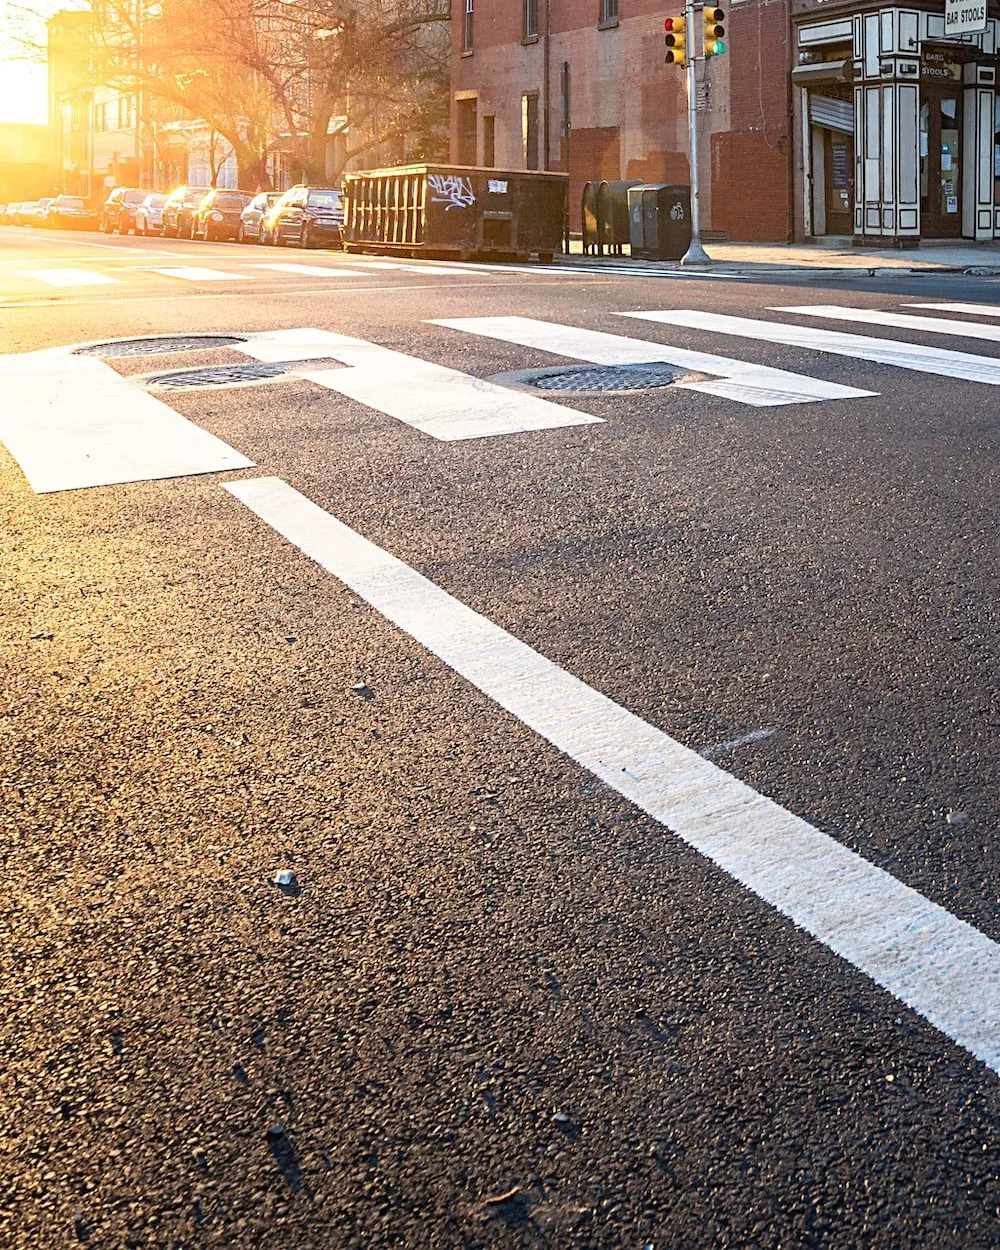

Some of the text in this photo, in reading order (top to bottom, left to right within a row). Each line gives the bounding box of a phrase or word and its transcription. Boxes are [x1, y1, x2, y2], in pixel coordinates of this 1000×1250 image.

[946, 6, 985, 25] BAR STOOLS
[921, 67, 949, 77] STOOLS
